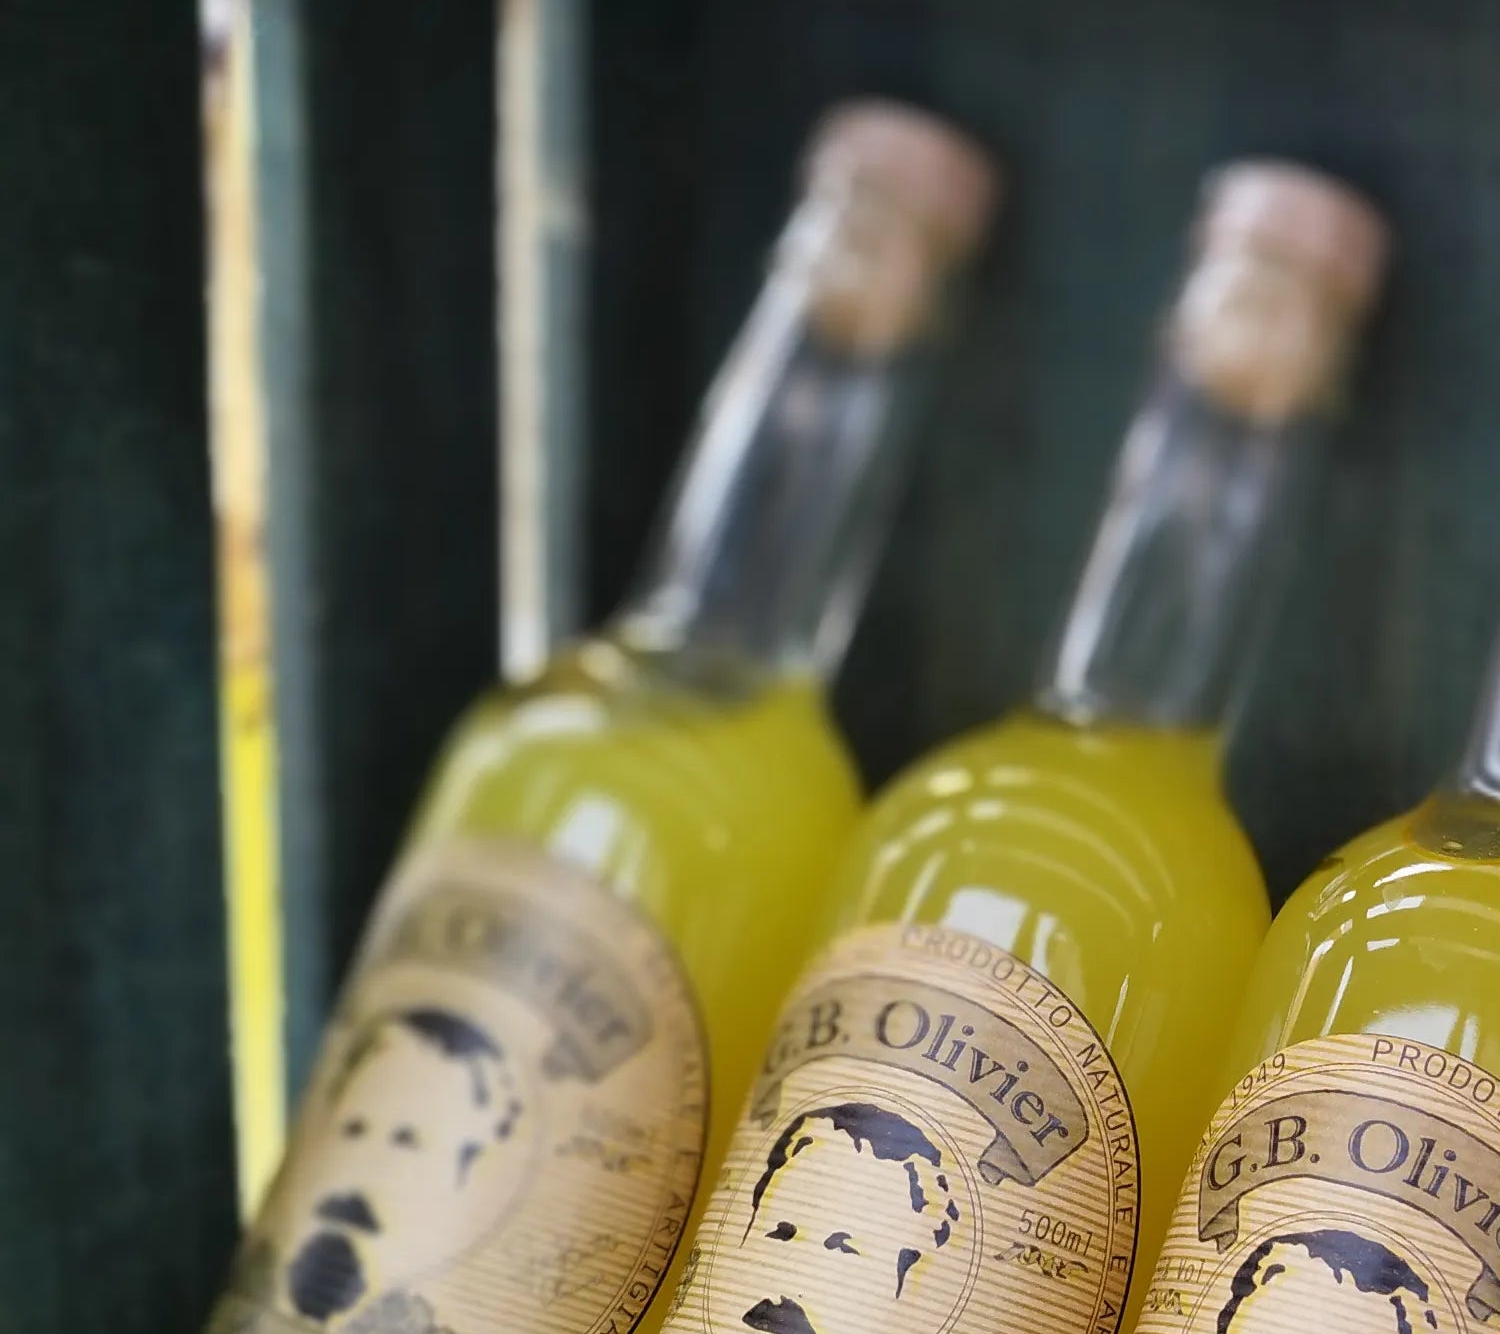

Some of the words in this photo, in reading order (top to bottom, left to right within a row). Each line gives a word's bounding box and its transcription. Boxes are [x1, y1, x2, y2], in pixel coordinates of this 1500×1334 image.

[875, 1000, 1069, 1148] Olivier
[901, 924, 1074, 1030] PRODOTTO
[1075, 1043, 1134, 1225] NATURALE
[1109, 1255, 1129, 1274] E
[1229, 1052, 1287, 1111] 1949
[1206, 1114, 1321, 1192] G.B.
[1017, 1208, 1094, 1258] 500ml
